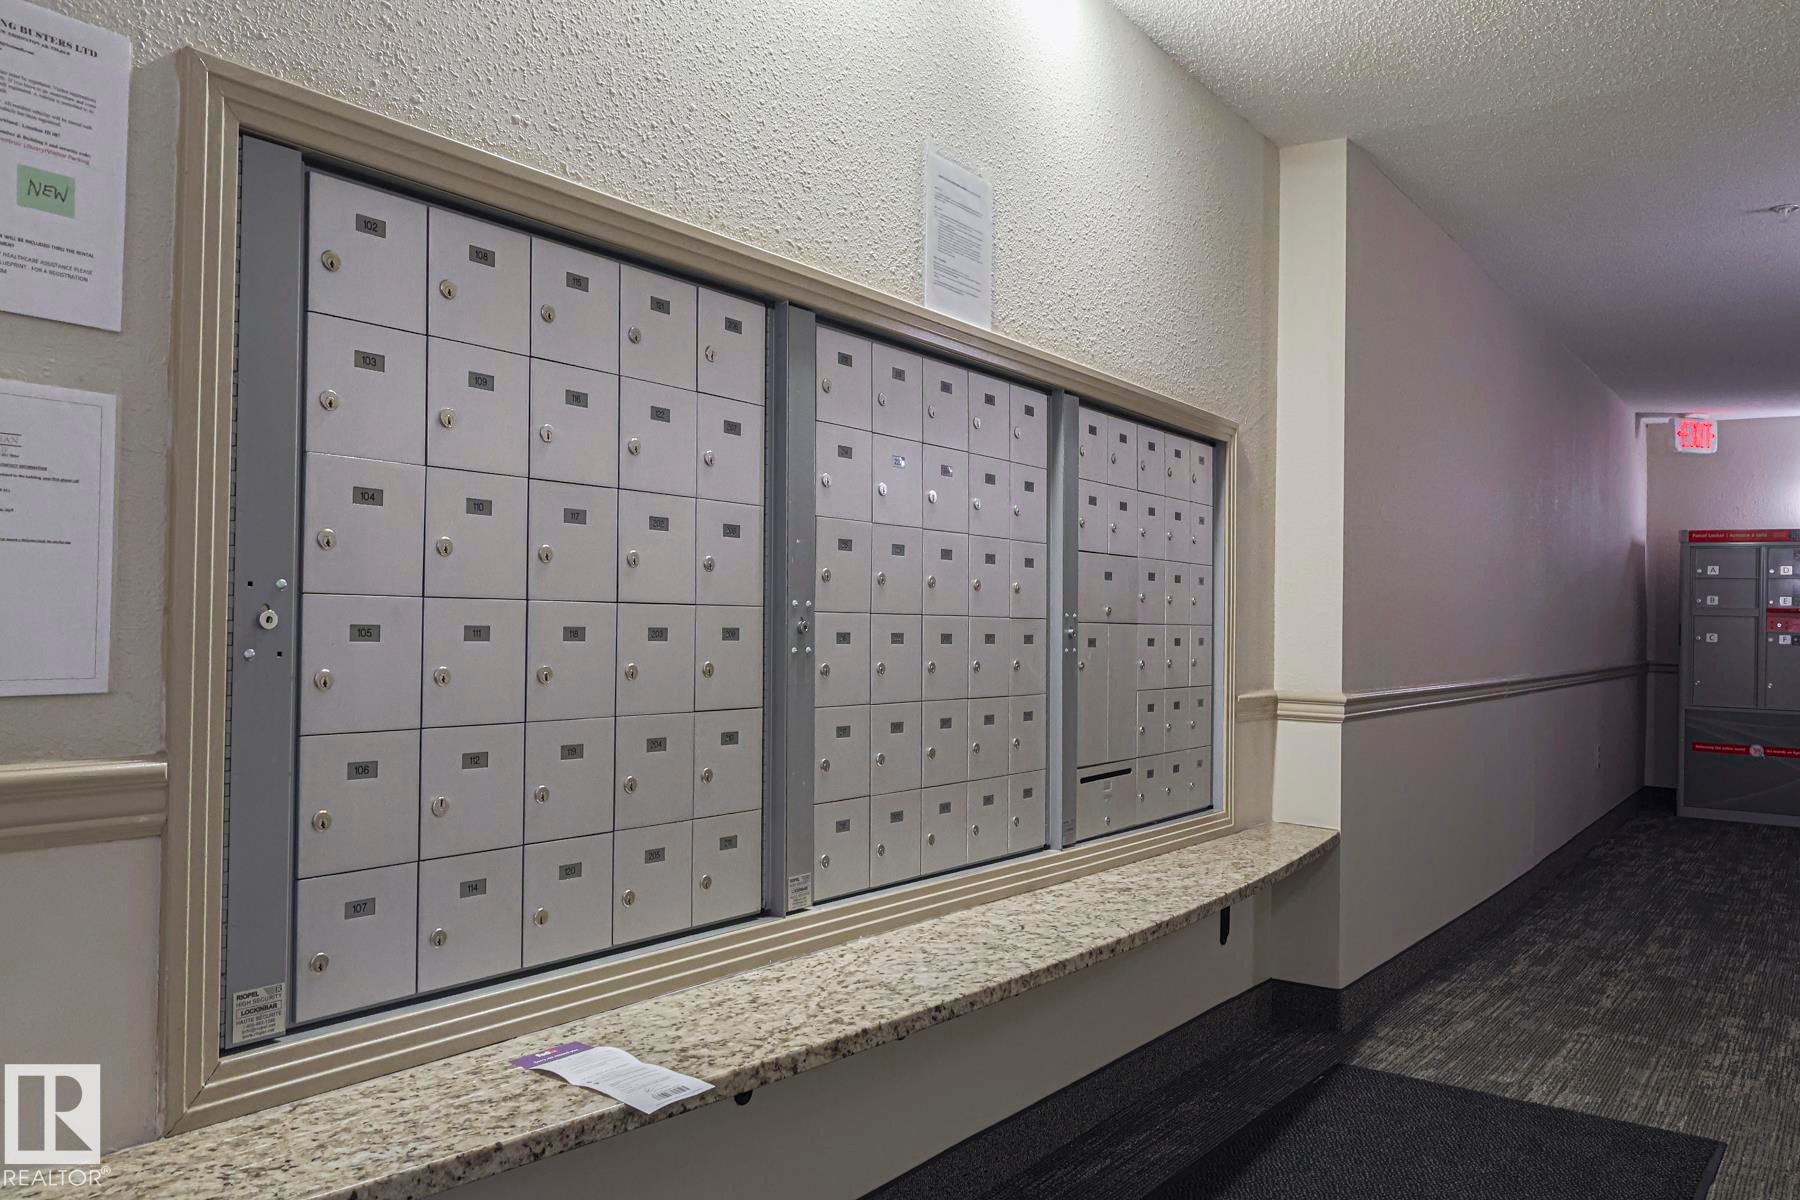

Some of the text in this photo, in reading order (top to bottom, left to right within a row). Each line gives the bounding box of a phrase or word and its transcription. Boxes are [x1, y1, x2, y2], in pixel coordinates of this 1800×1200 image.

[20, 26, 73, 49] BUSTERS
[76, 45, 98, 57] LTD
[28, 179, 69, 202] NEW
[363, 220, 378, 232] 102
[475, 250, 488, 261] 108
[0, 261, 26, 270] UEPRINT
[571, 277, 582, 288] 115
[362, 356, 376, 367] 103
[475, 375, 488, 386] 109
[572, 394, 581, 403] 116
[1681, 421, 1712, 449] EXIT
[360, 492, 375, 501] 104
[473, 502, 484, 512] 110
[571, 512, 580, 520] 117
[357, 628, 372, 638] 105
[472, 629, 481, 638] 111
[470, 755, 480, 765] 112
[355, 765, 369, 775] 106
[468, 883, 478, 893] 114
[353, 902, 367, 913] 107
[236, 991, 260, 1000] RIOPEL
[252, 993, 282, 1004] SECURITY
